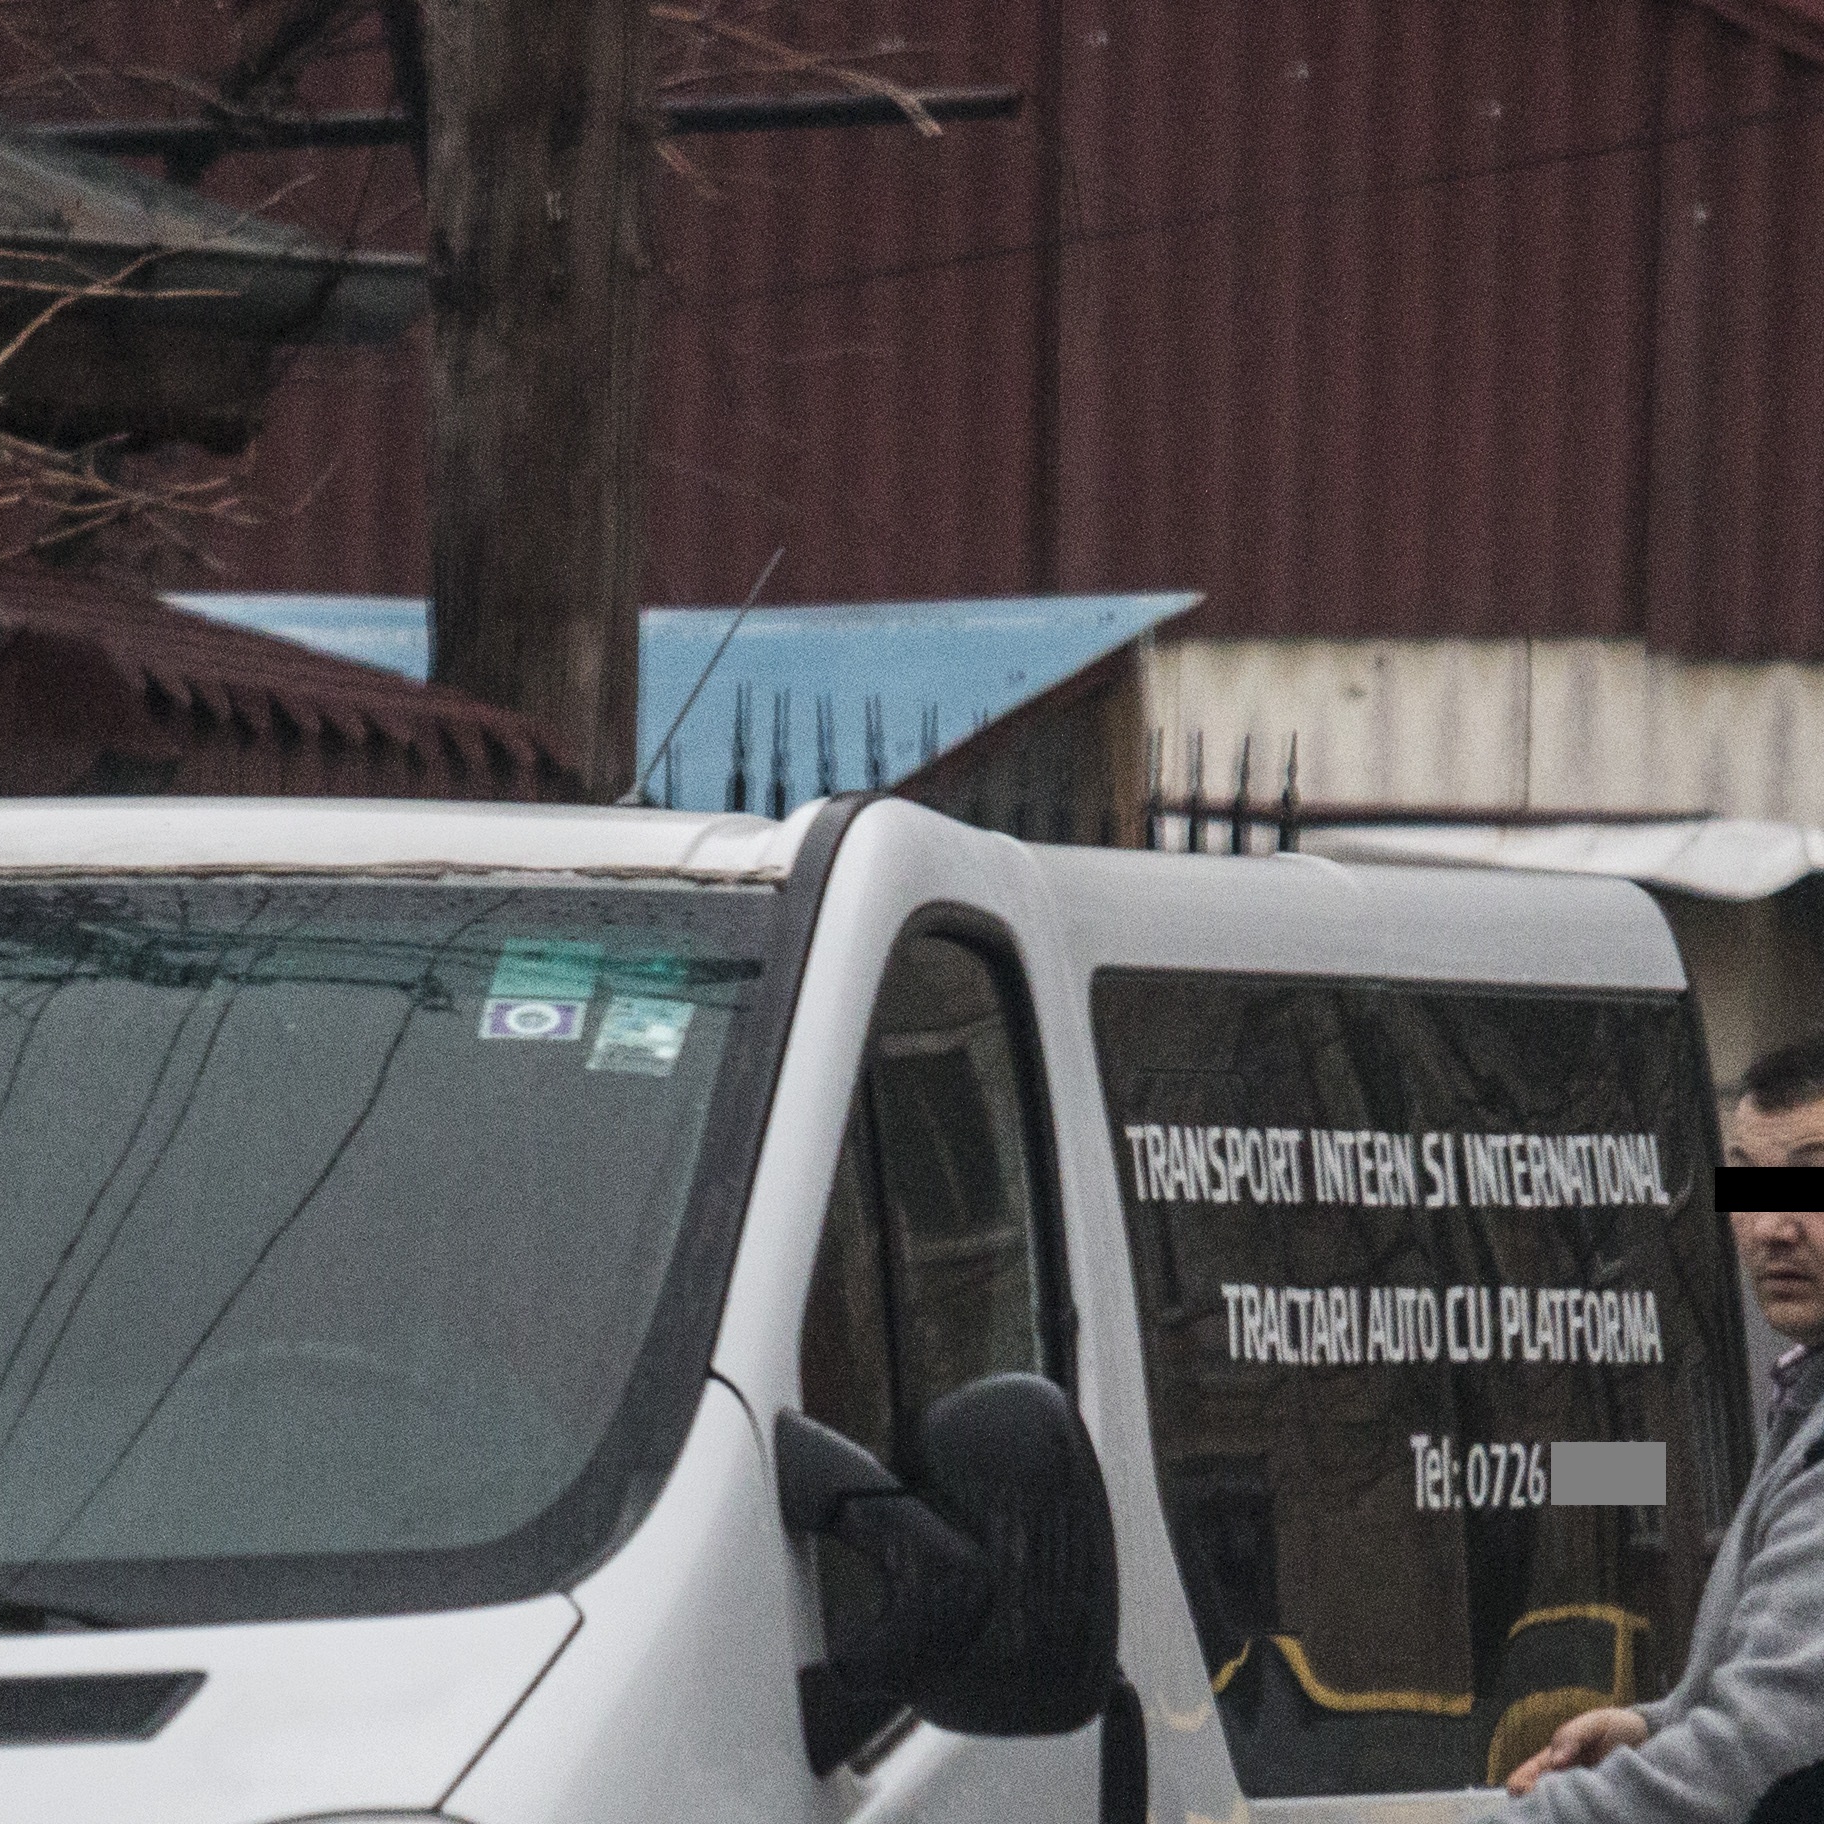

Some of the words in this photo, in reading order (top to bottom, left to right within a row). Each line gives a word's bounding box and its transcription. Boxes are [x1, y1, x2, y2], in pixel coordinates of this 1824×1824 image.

[1124, 1124, 1303, 1204] TRANSPORT
[1310, 1128, 1417, 1206] INTERN
[1422, 1131, 1458, 1208] SI
[1463, 1132, 1670, 1207] INTERNATIONAL
[1220, 1283, 1362, 1365] TRACTARI
[1367, 1286, 1440, 1364] AUTO
[1445, 1285, 1491, 1363] CU
[1499, 1286, 1664, 1364] PLATFORMA
